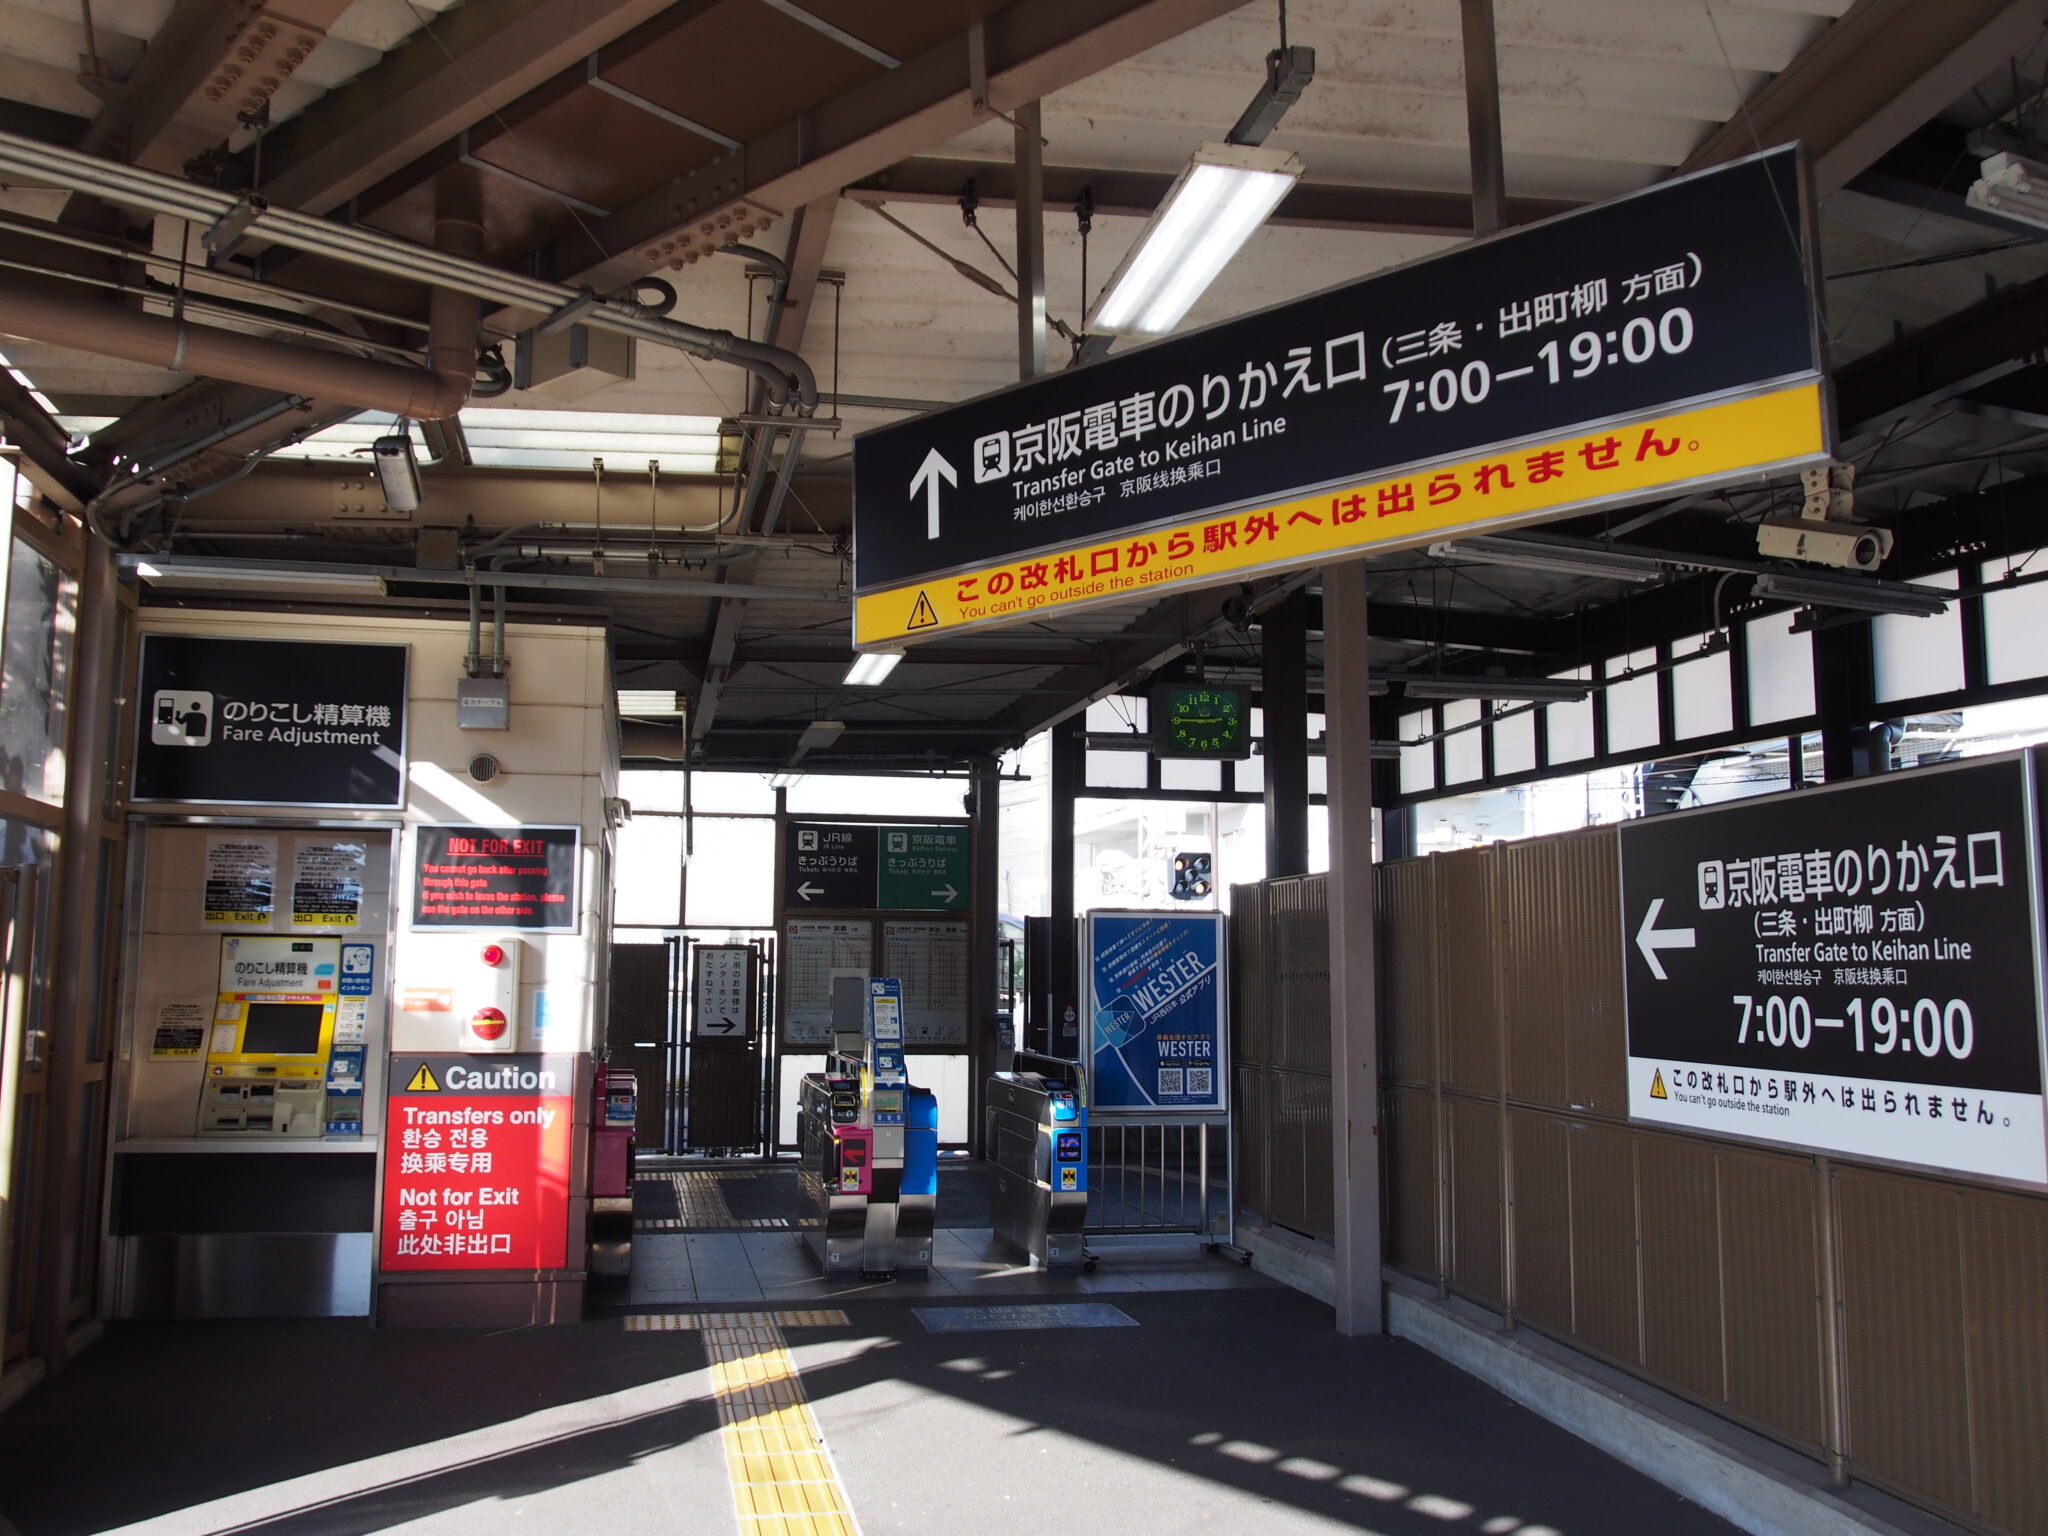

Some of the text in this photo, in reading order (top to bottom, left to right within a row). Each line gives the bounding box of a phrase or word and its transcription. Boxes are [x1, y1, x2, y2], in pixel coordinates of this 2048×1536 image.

[1012, 331, 1367, 472] 京阪電車のりかえ口
[1013, 415, 1287, 500] Transfer Gate to Keihan Line
[1119, 458, 1221, 498] 京阪线换乘口
[956, 428, 1700, 604] この改札口から駅外へは出られません。
[959, 563, 1194, 620] You can't go outside the station
[1189, 696, 1198, 704] 11
[1200, 694, 1210, 702] 12
[1214, 696, 1218, 704] 1
[222, 701, 392, 728] のりこし精算機
[1174, 716, 1180, 724] 9
[1228, 717, 1234, 726] 3
[222, 726, 380, 747] Fare Adjustment
[1179, 730, 1186, 738] 8
[1190, 738, 1196, 746] 7
[1212, 738, 1218, 746] 5
[1222, 730, 1229, 738] 4
[1200, 740, 1208, 748] 6
[823, 832, 853, 843] JR線
[911, 834, 957, 845] 京阪電車
[449, 838, 544, 854] NOT FOR EXIT
[798, 855, 858, 866] きっぷうりば
[888, 858, 946, 868] きっぷうりば
[423, 864, 548, 876] You cannot go back after passing
[1725, 830, 2004, 908] 京阪電車のりかえ口
[423, 877, 488, 888] through this gate
[429, 892, 445, 901] you
[446, 891, 464, 901] wish
[465, 892, 474, 901] to
[474, 892, 495, 901] leave
[496, 892, 509, 901] the
[540, 893, 566, 903] please
[205, 913, 224, 921] 出口
[234, 912, 254, 921] Exit
[294, 914, 313, 922] 出口
[322, 914, 342, 923] Exit
[437, 905, 450, 913] the
[451, 905, 469, 916] gate
[469, 906, 480, 914] on
[481, 905, 494, 914] the
[494, 905, 515, 914] other
[227, 938, 240, 947] JR
[1755, 937, 1972, 963] Transfer Gate to Keihan Line
[234, 962, 308, 975] のりこし精算機
[1757, 967, 1822, 986] 케이한선환승구
[1833, 967, 1908, 986] 京阪线换乘口
[237, 977, 303, 988] Fare Adjustment
[704, 952, 714, 1014] おたずね下さい
[718, 952, 727, 1014] インターホンで
[731, 952, 741, 1014] ご用のお客様は
[1131, 951, 1207, 1012] WESTER
[1103, 1012, 1132, 1034] WESTER
[1157, 1040, 1211, 1057] WESTER
[445, 1066, 556, 1090] Caution
[1673, 1069, 2011, 1128] この改札口から駅外へは出られません。
[1674, 1091, 1790, 1116] You can't go outside the station
[403, 1107, 555, 1129] Transfers only
[402, 1128, 488, 1149] 환승 전용
[400, 1152, 492, 1174] 换乘专用
[400, 1187, 519, 1206] Not for Exit
[398, 1209, 484, 1230] 출구 아님
[397, 1233, 511, 1255] 此处非出口
